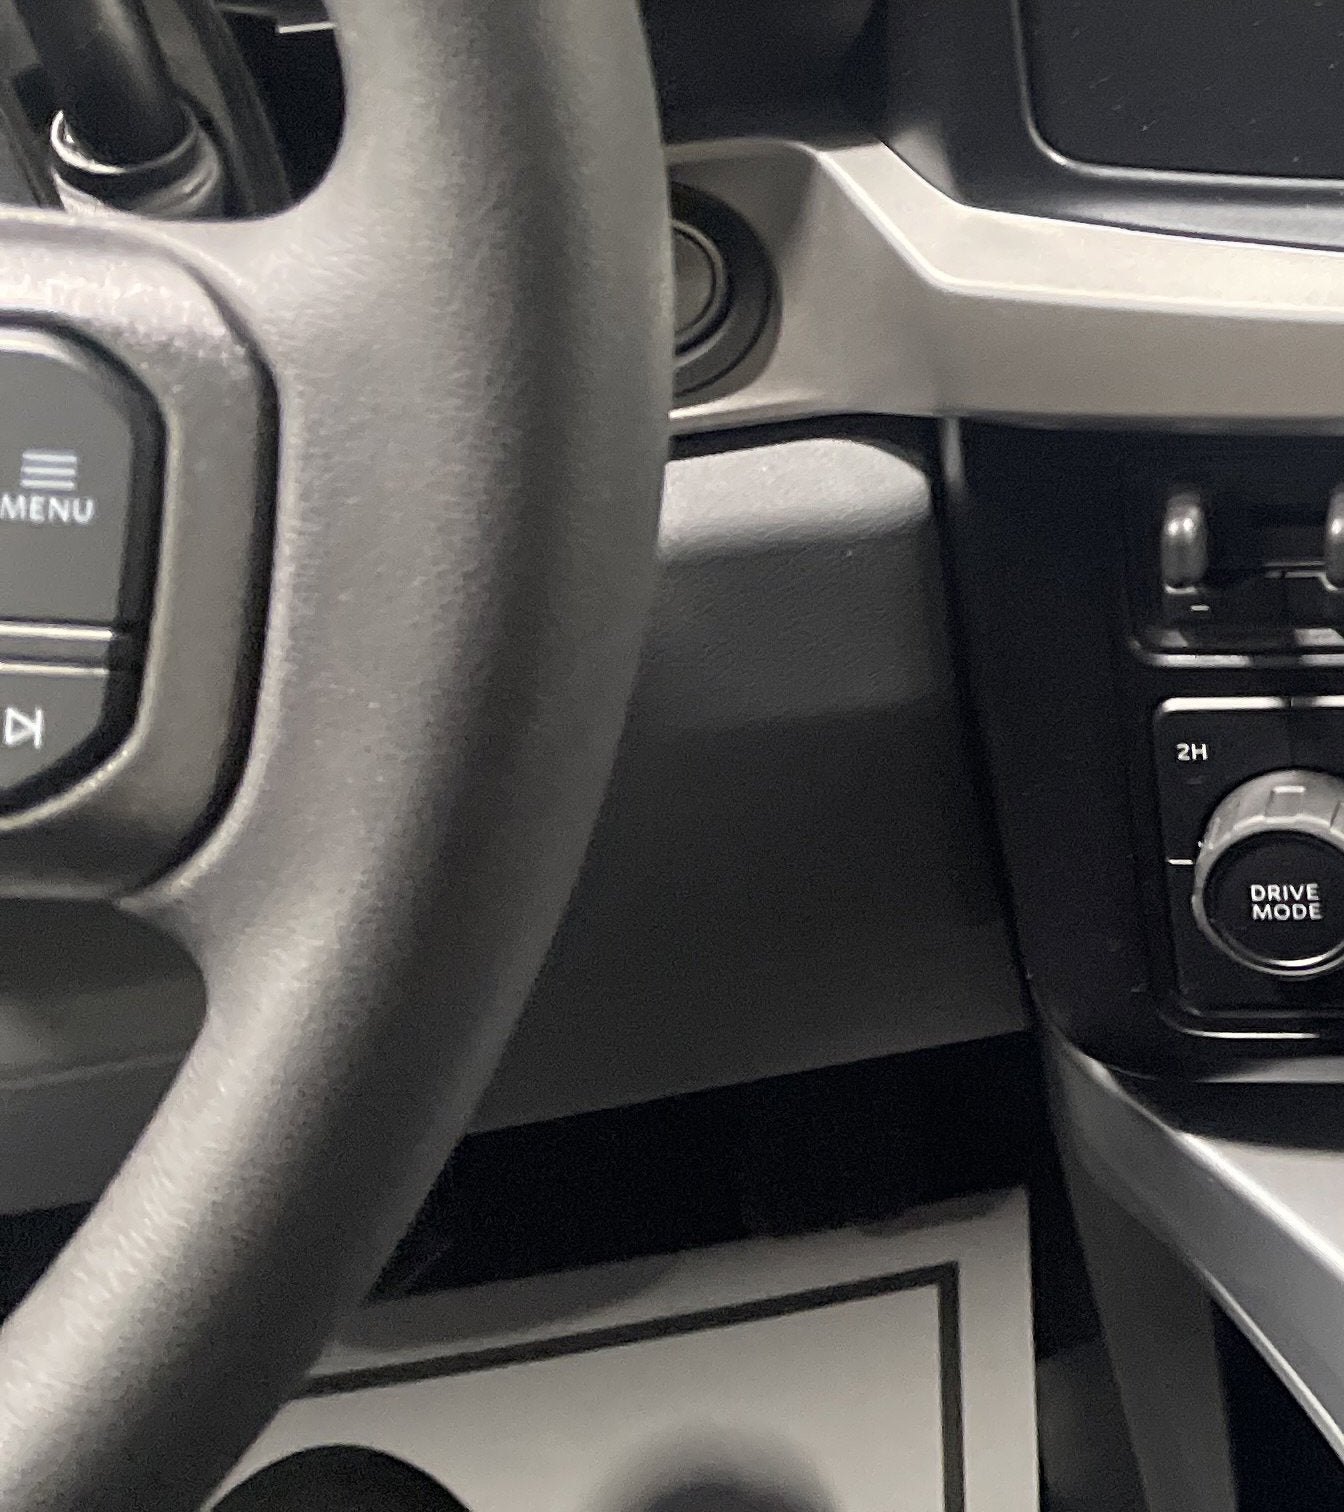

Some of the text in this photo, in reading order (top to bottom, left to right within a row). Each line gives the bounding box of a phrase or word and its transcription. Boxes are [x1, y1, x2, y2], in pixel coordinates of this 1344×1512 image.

[0, 494, 94, 524] MENU
[1175, 743, 1208, 761] 2H
[1250, 883, 1320, 902] DRIVE
[1252, 902, 1324, 921] MODE
